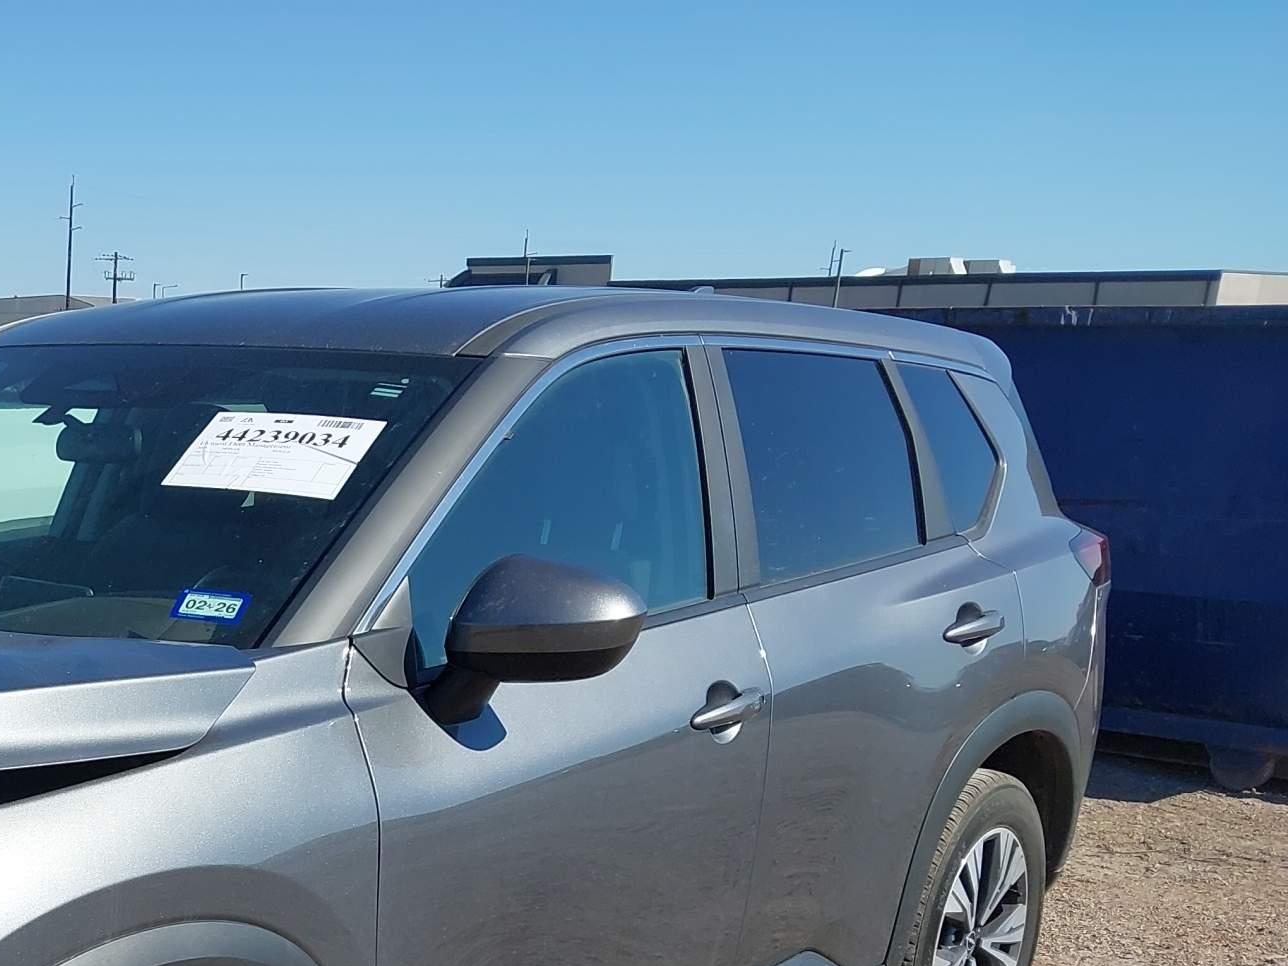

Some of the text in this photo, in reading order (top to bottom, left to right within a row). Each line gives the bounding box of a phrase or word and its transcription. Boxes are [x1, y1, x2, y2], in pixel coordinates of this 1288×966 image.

[215, 428, 351, 449] 44239034
[185, 599, 238, 614] 02 26
